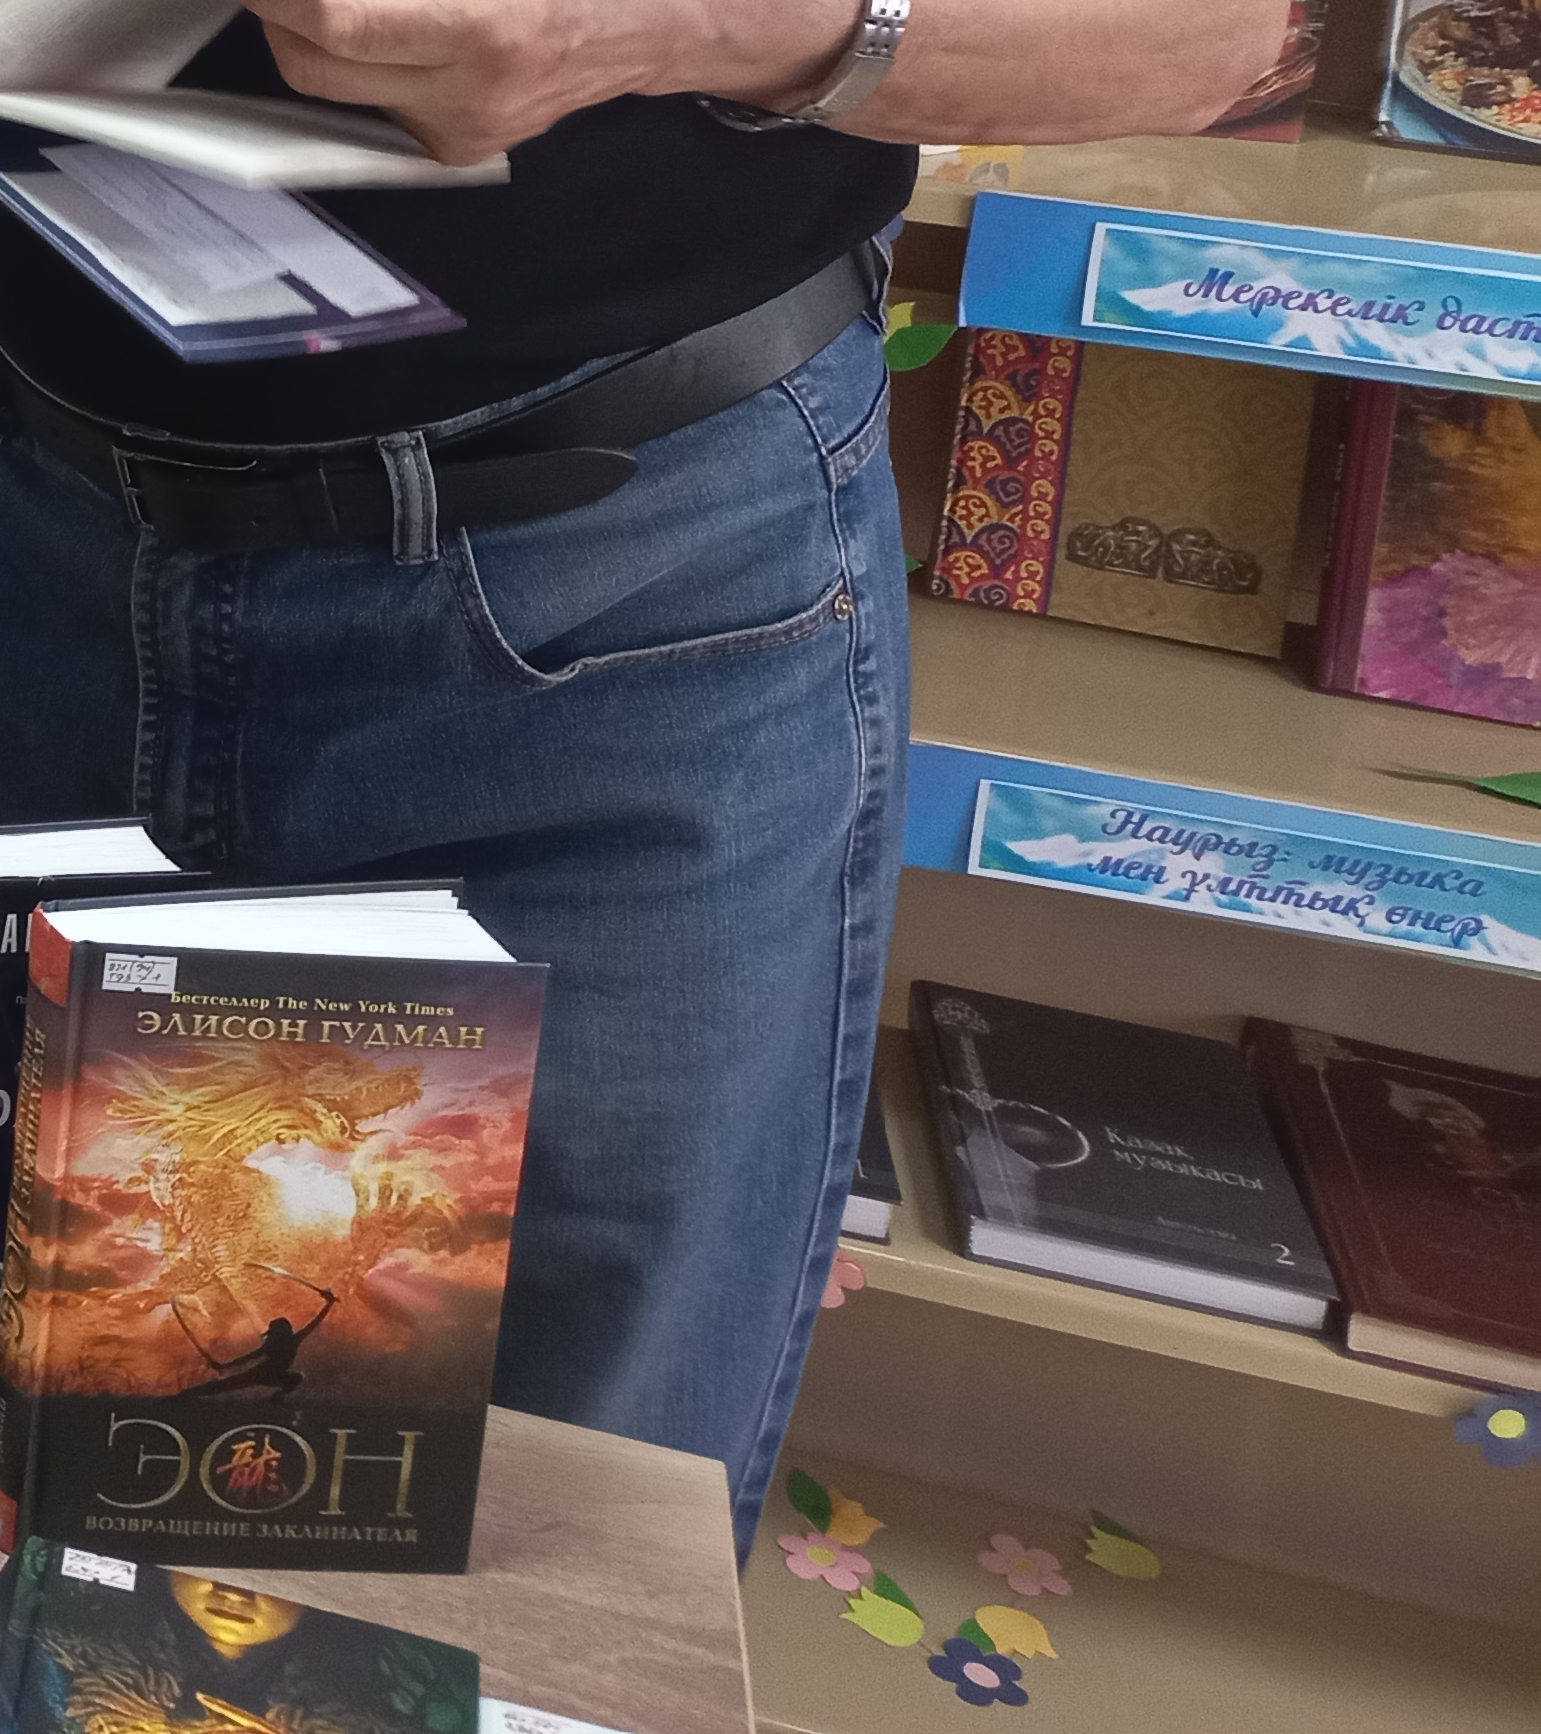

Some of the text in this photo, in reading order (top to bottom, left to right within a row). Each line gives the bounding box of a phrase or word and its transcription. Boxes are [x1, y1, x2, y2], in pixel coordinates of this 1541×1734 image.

[1182, 266, 1427, 328] Мерекелік
[1310, 845, 1488, 899] музыка
[1087, 854, 1168, 885] мен
[1383, 896, 1488, 950] өнер
[169, 990, 271, 1012] Бестселлер
[275, 994, 455, 1017] The New York Times
[136, 1009, 487, 1052] ЭЛИСОН ГУДМАН
[1271, 1242, 1297, 1266] 2
[95, 1411, 426, 1519] ЭОН
[85, 1514, 419, 1544] ВОЗВРАЩЕНИЕ ЗАКЛИНАТЕЛЯ
